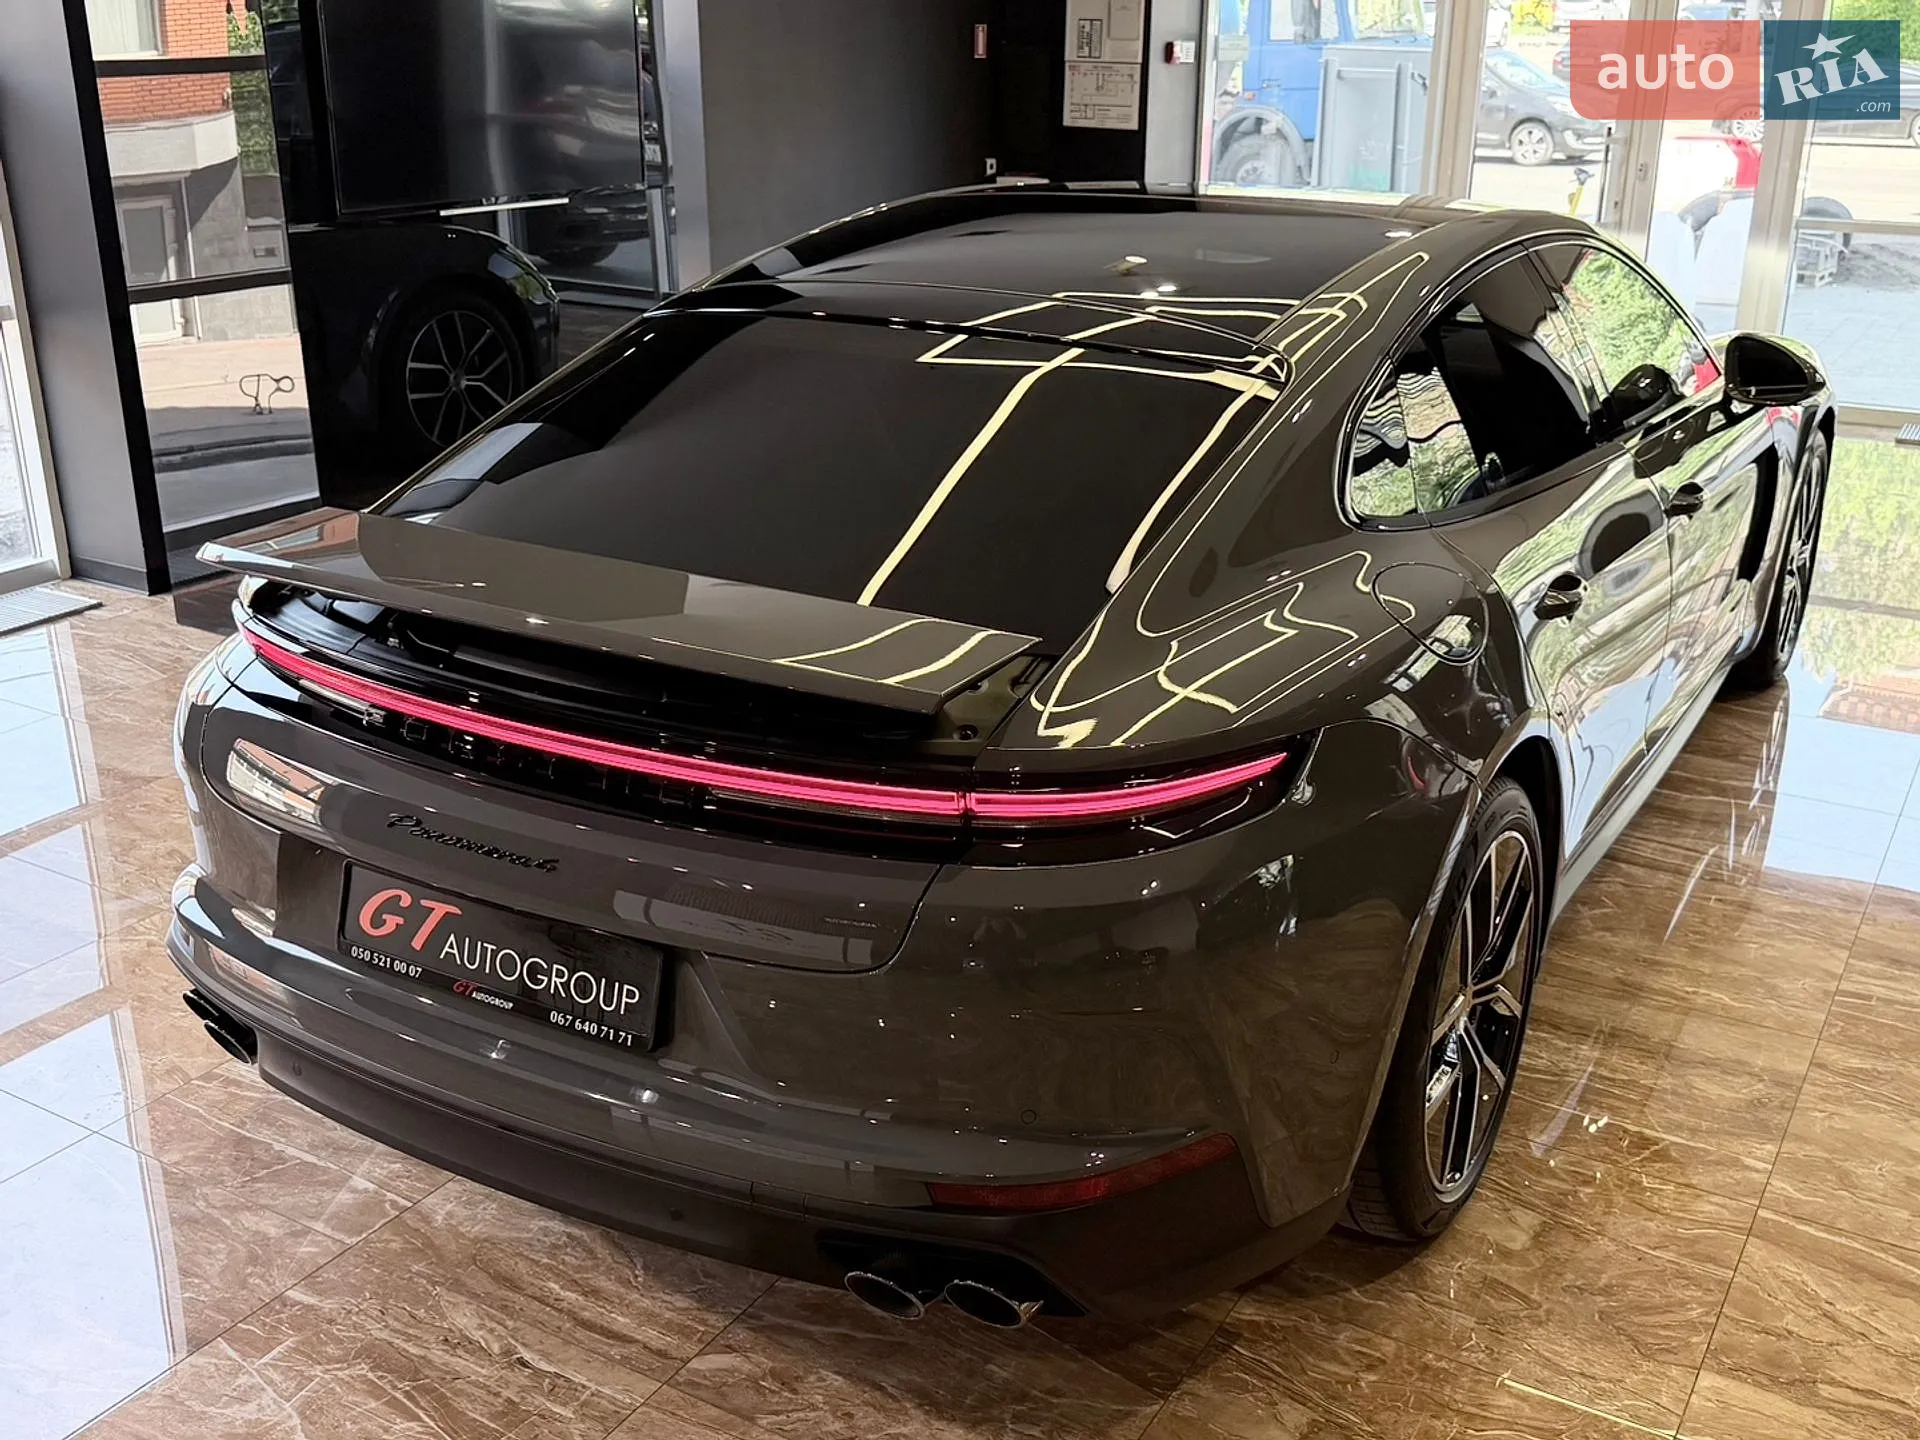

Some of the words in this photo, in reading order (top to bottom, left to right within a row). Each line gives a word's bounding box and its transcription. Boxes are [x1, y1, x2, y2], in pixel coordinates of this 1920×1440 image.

[351, 946, 371, 962] 050
[372, 953, 391, 968] 521
[393, 960, 407, 976] 00
[408, 966, 423, 979] 07
[358, 888, 463, 951] GT
[439, 933, 640, 1015] AUTOGROUP
[453, 981, 477, 996] GT
[472, 991, 514, 1009] AUTOGROUP
[550, 1010, 573, 1027] 067
[574, 1018, 598, 1035] 640
[600, 1026, 614, 1041] 71
[618, 1031, 632, 1046] 71
